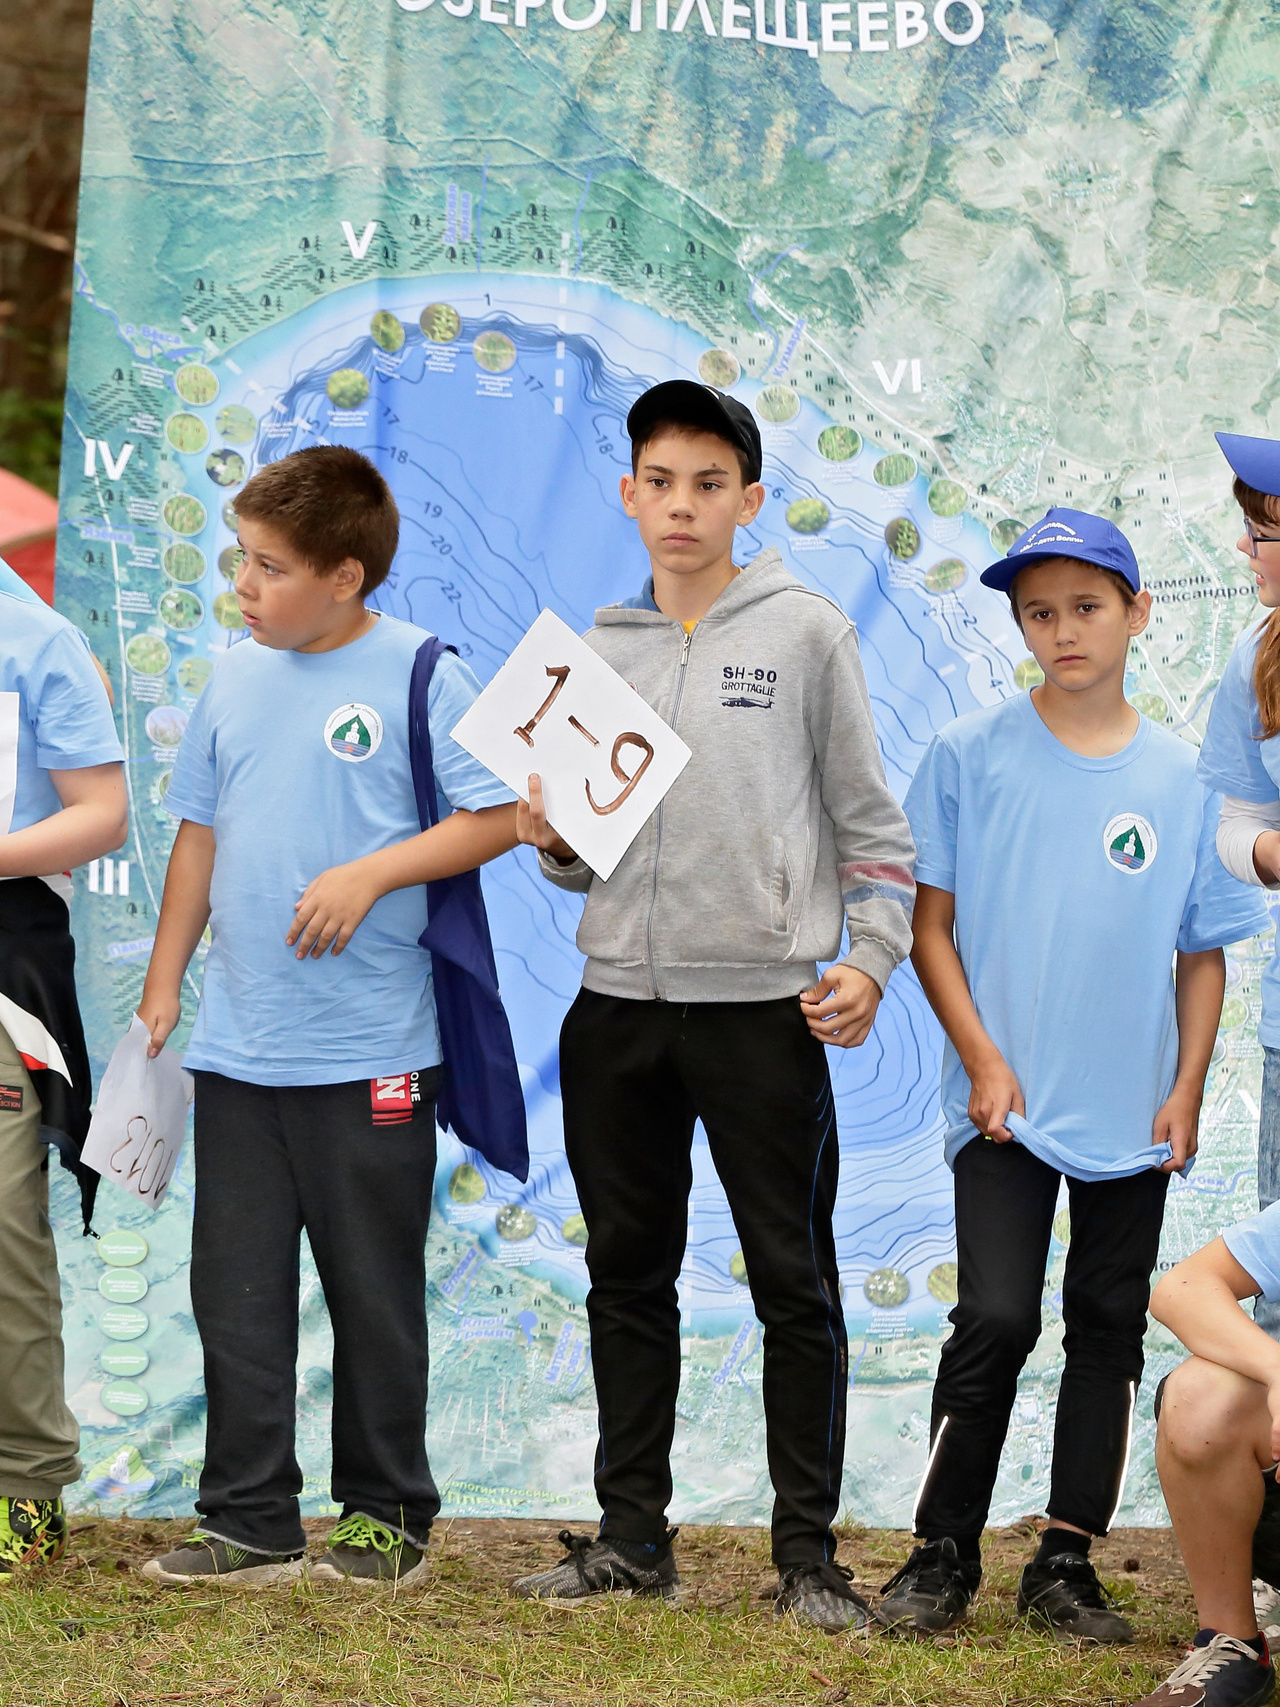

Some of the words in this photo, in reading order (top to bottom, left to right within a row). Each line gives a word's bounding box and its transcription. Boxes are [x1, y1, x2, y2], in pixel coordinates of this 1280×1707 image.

[396, 0, 607, 31] ЕРО
[628, 0, 985, 58] ПЛЕЩЕЕВО
[340, 220, 378, 260] V
[523, 375, 544, 393] 17
[872, 359, 922, 395] VI
[382, 407, 401, 426] 17
[389, 446, 409, 464] 18
[595, 434, 614, 455] 18
[83, 438, 135, 480] IV
[422, 501, 443, 518] 19
[431, 535, 453, 556] 20
[441, 582, 462, 604] 22
[1143, 575, 1211, 590] камень
[1150, 585, 1260, 604] лександров
[963, 616, 977, 628] 2
[723, 666, 777, 683] SH-90
[721, 681, 777, 698] GROTTAGLIE
[513, 664, 654, 816] 1-9
[88, 857, 130, 897] III
[410, 1072, 421, 1102] ONE
